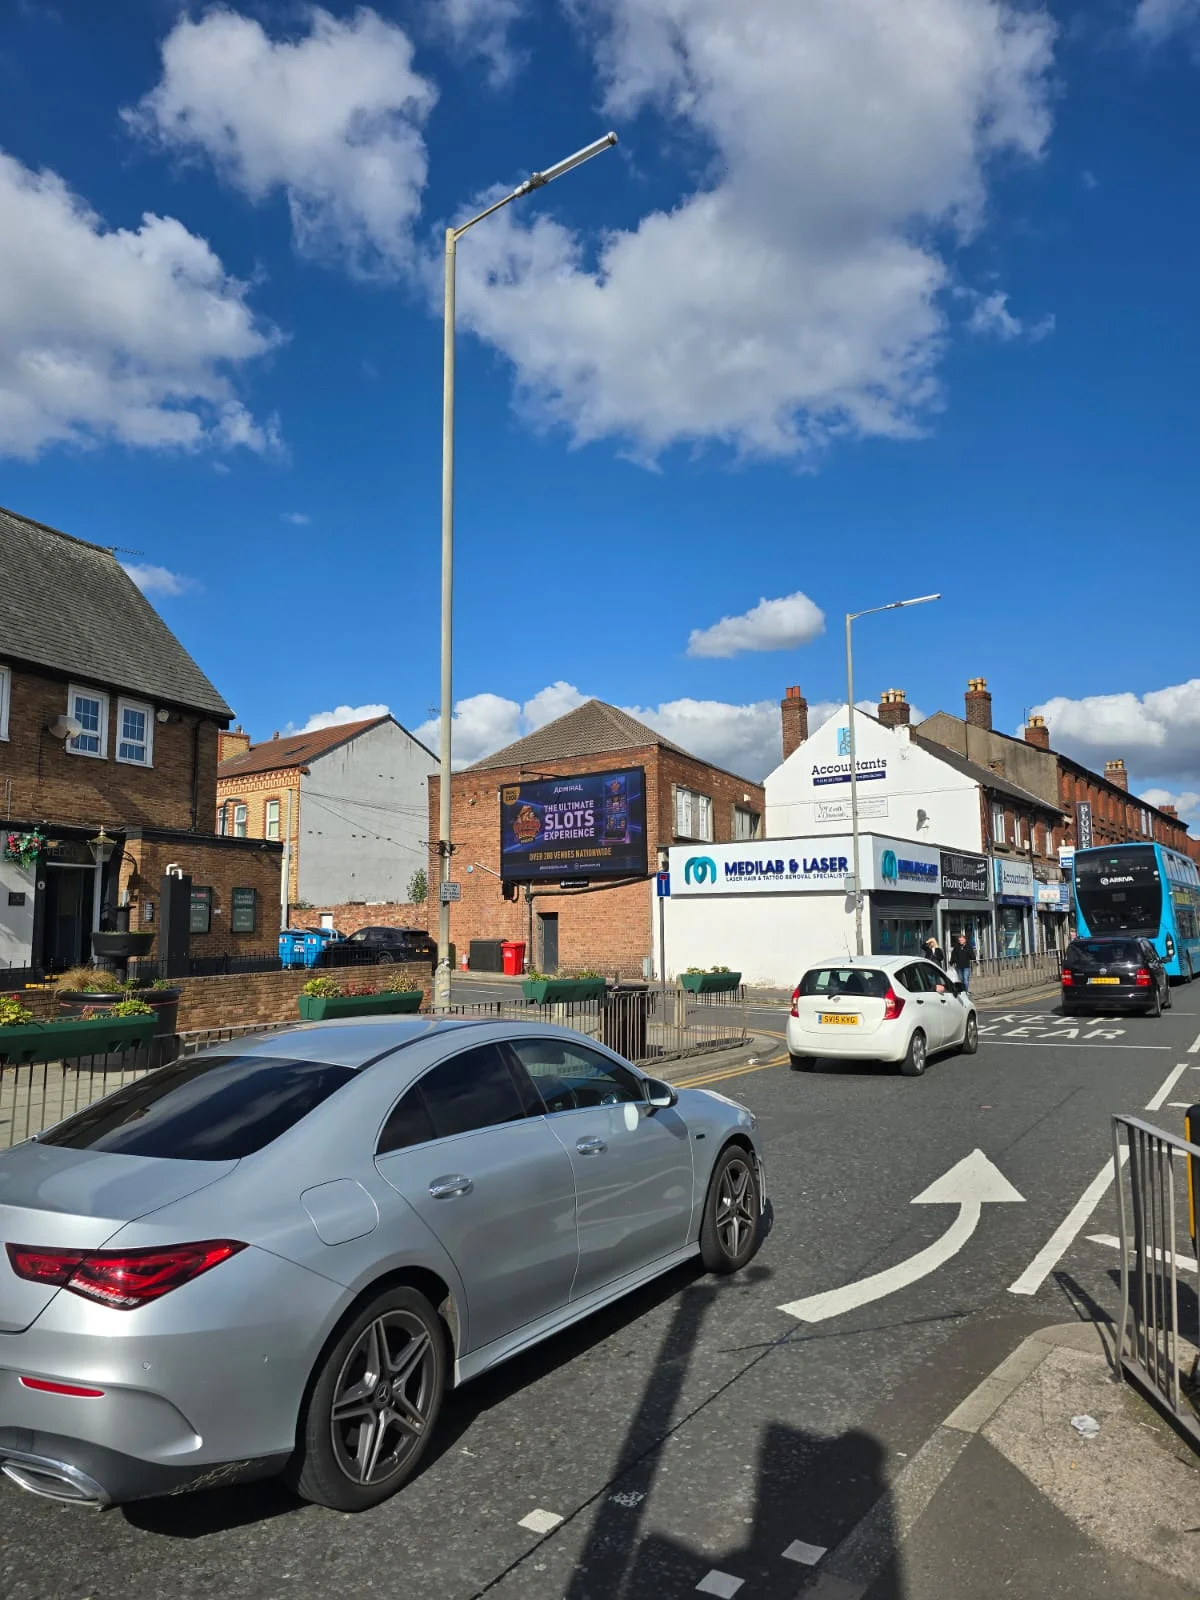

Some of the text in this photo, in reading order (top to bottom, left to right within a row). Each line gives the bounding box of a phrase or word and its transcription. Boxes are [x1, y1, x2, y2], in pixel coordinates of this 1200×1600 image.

[554, 784, 583, 793] ADMIRAL
[544, 800, 594, 813] THE ULTIMATE
[544, 810, 595, 830] SLOTS
[1080, 804, 1090, 849] BLONDE
[544, 828, 595, 841] EXPERIENCE
[724, 860, 785, 876] MEDILAB
[803, 857, 848, 873] LASER
[1109, 876, 1134, 884] ARRIVA
[978, 1025, 1126, 1040] LEAR
